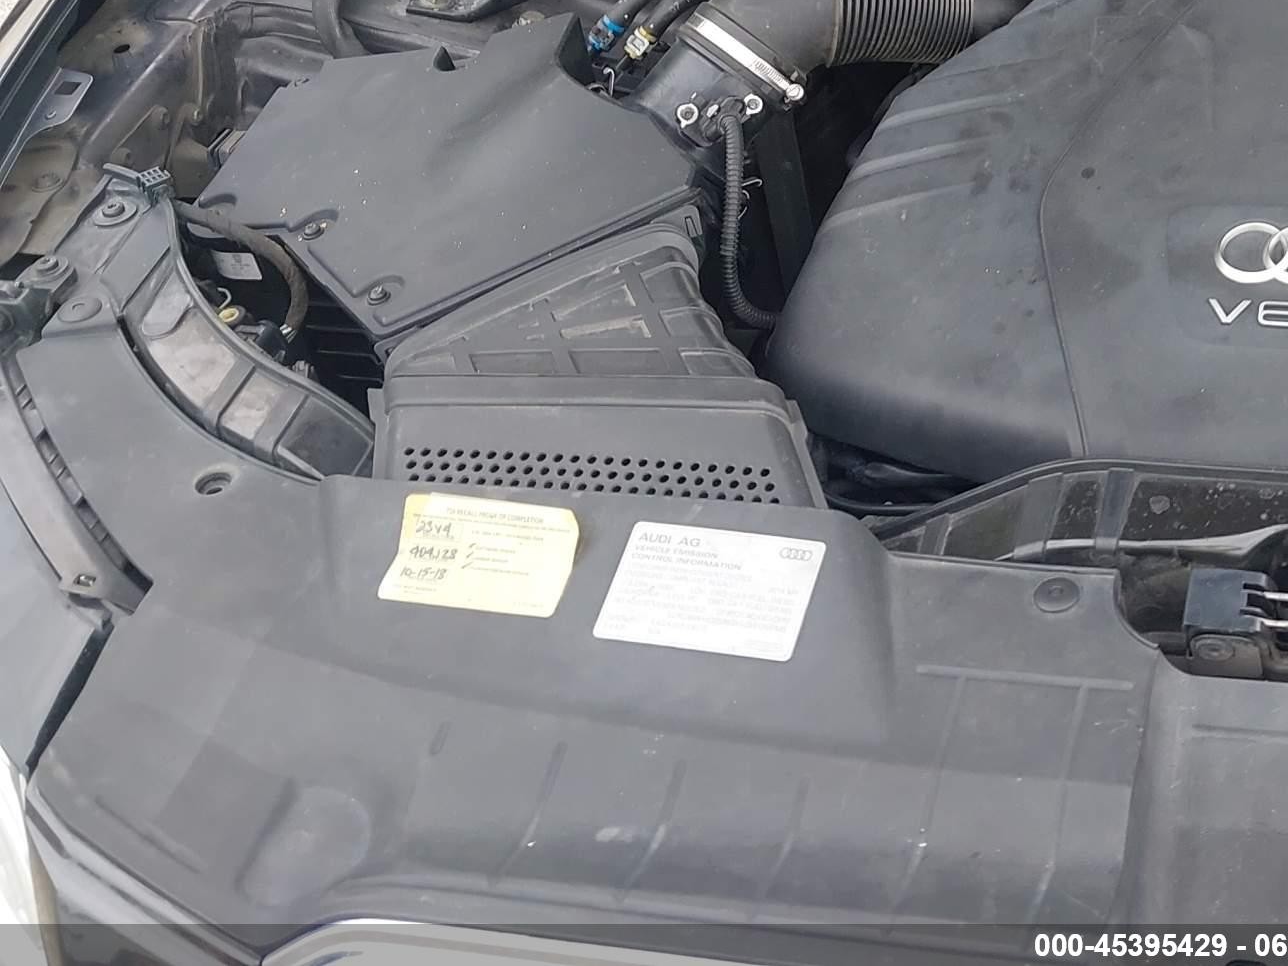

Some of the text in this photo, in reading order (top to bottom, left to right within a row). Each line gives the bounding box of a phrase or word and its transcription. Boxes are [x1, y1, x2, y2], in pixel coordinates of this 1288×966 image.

[639, 532, 701, 547] AUDI AG
[635, 544, 718, 559] VEHICLE EMISSION
[632, 553, 742, 571] CONTROL INFORMATION
